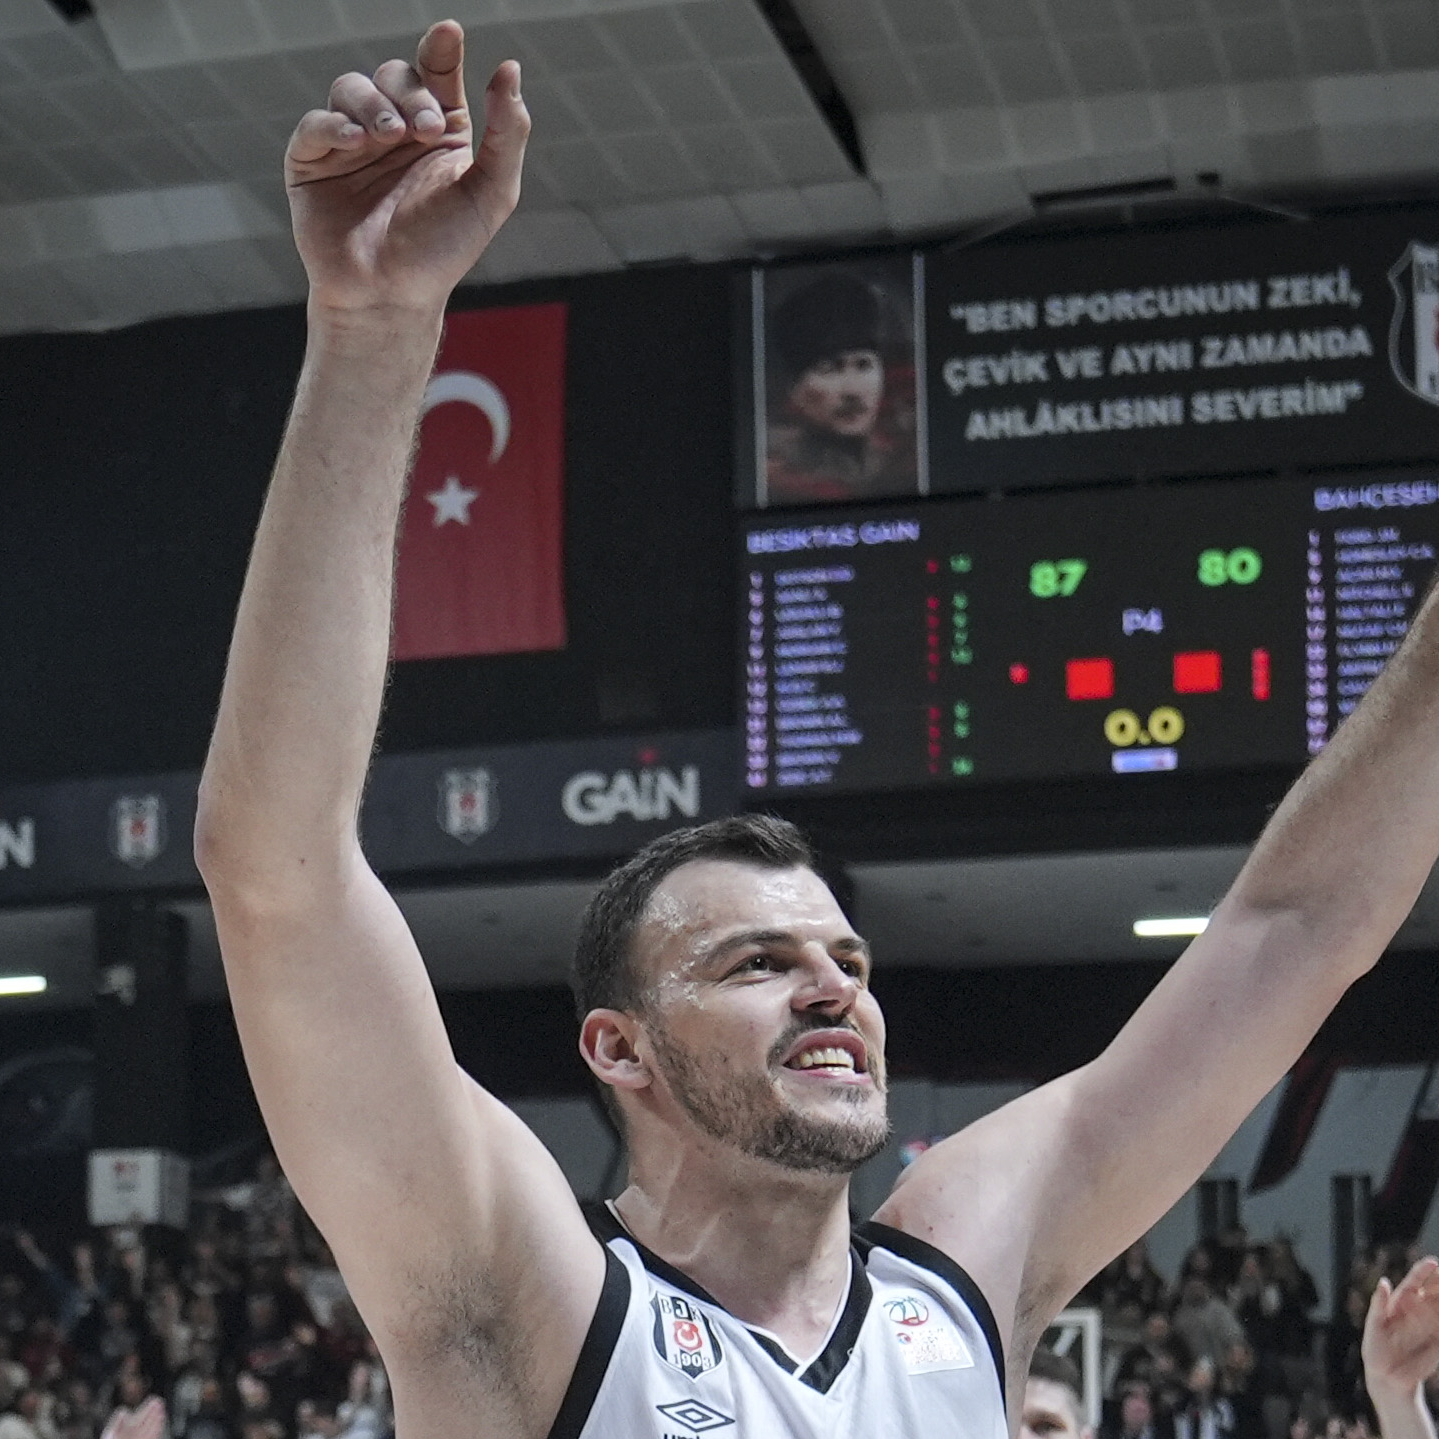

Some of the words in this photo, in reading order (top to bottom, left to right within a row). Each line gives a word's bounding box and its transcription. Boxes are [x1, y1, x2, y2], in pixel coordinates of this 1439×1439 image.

[1044, 280, 1258, 327] SPORCUNUN
[943, 350, 1049, 395] ÇEVİK
[1056, 346, 1104, 379] VE
[1111, 339, 1194, 375] AYNI
[1199, 326, 1373, 369] ZAMANDA
[1029, 558, 1088, 598] 87
[1197, 547, 1262, 587] 80
[1104, 705, 1185, 747] 0.0
